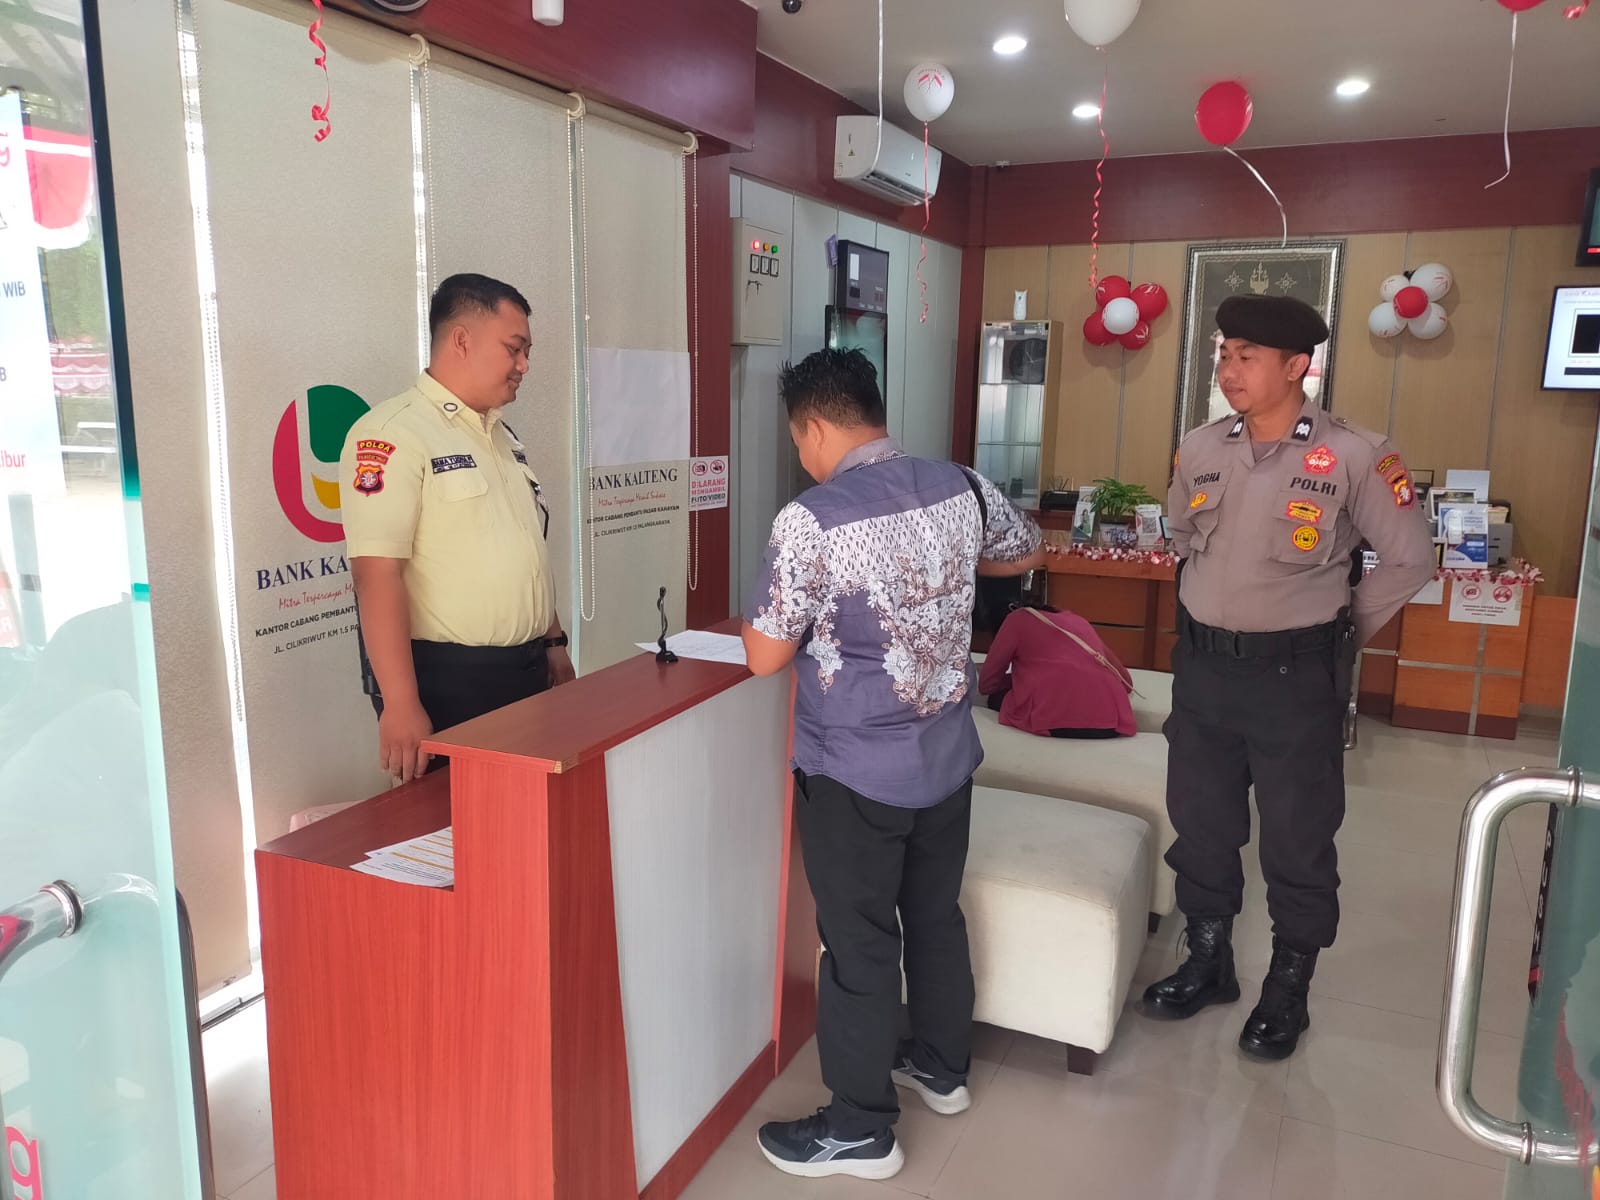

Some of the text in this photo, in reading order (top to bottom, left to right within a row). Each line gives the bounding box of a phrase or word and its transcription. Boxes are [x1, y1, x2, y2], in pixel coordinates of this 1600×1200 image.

[3, 281, 26, 298] WIB
[360, 441, 391, 454] POLDA
[0, 449, 26, 468] ibur
[624, 467, 678, 487] KALTENG
[1193, 471, 1221, 487] YOGHA
[1290, 476, 1337, 497] POLRI
[256, 555, 349, 591] BANK KA
[278, 597, 301, 611] Mitra
[255, 622, 289, 638] KANTOR
[290, 614, 320, 629] CABANG
[286, 632, 326, 650] CILIKRIWUT
[327, 628, 338, 638] KM
[340, 625, 349, 635] 1.5
